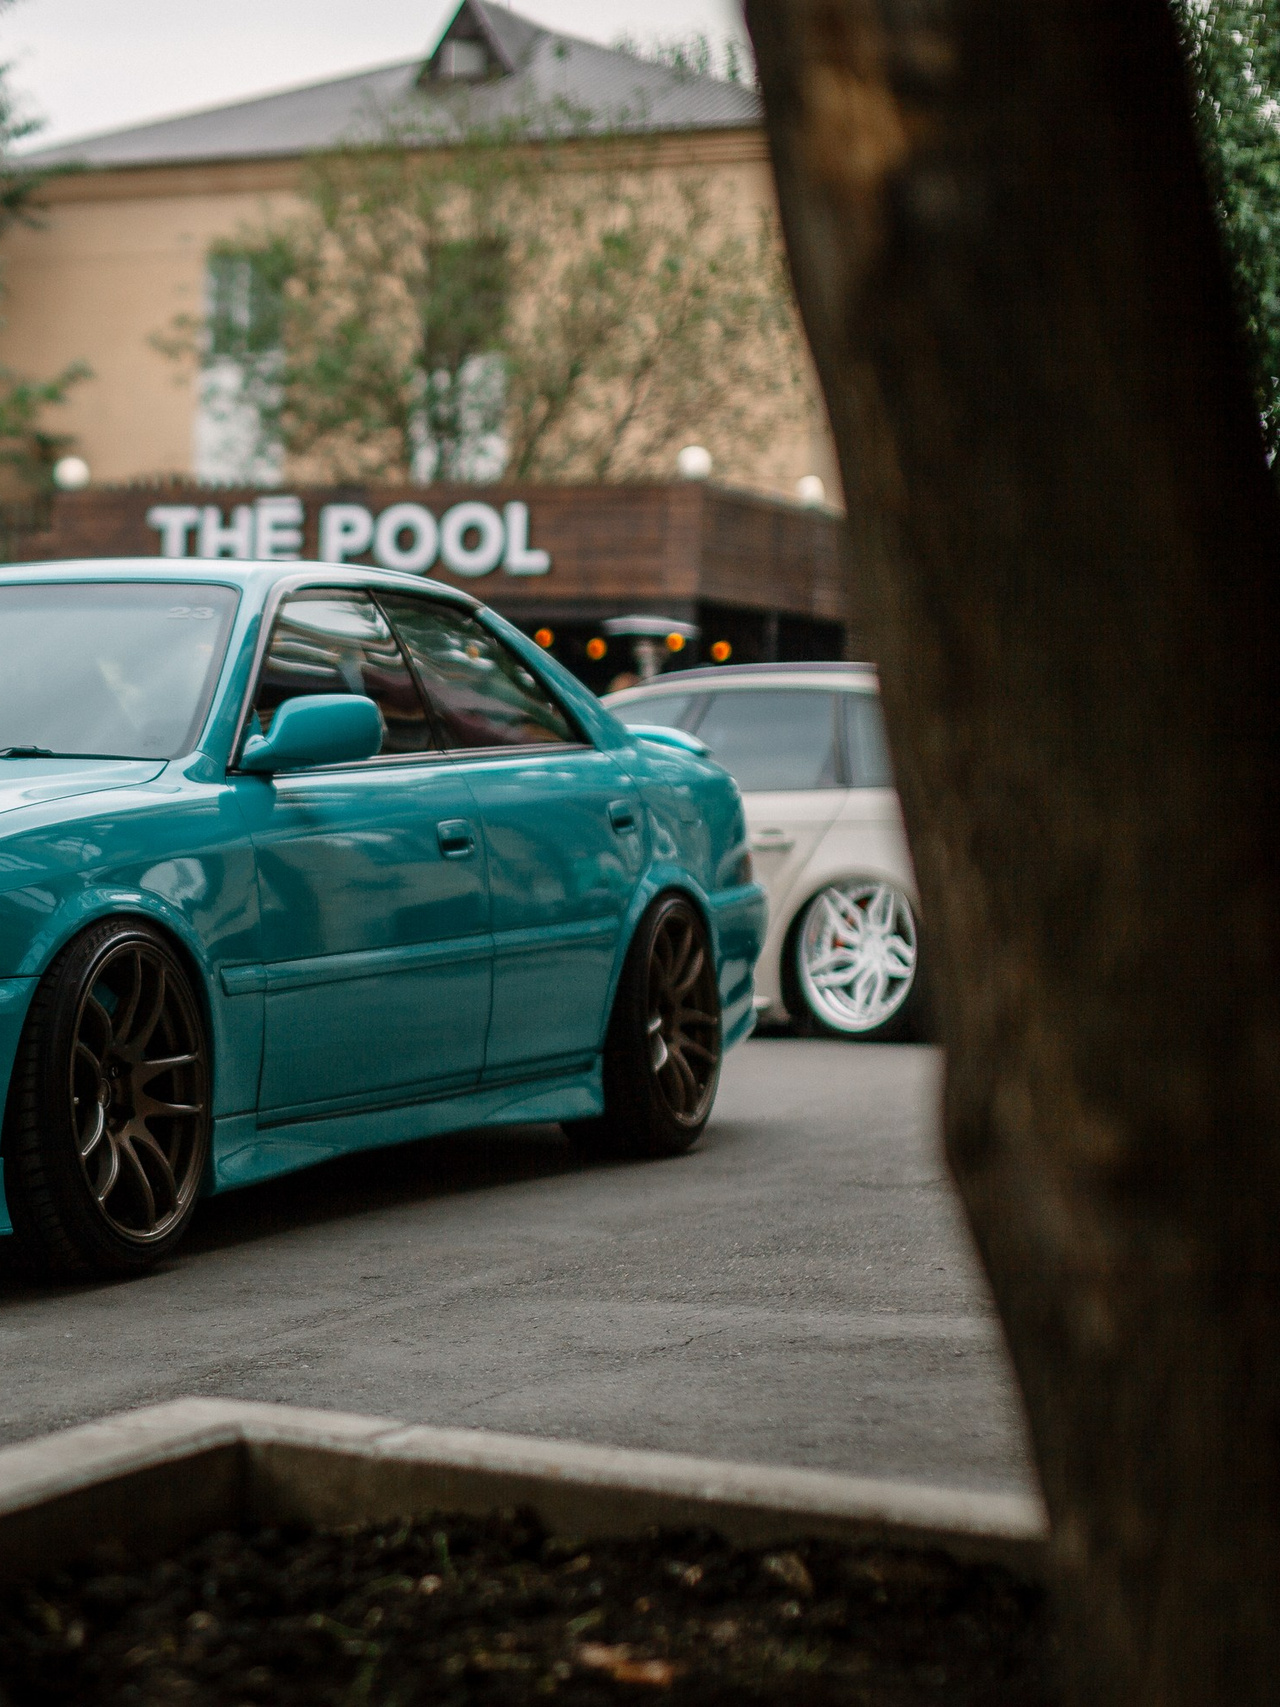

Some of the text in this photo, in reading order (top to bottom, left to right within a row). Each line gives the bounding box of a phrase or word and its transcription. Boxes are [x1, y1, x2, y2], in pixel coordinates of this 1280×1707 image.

[146, 496, 551, 577] THE POOL
[166, 606, 215, 619] 23
